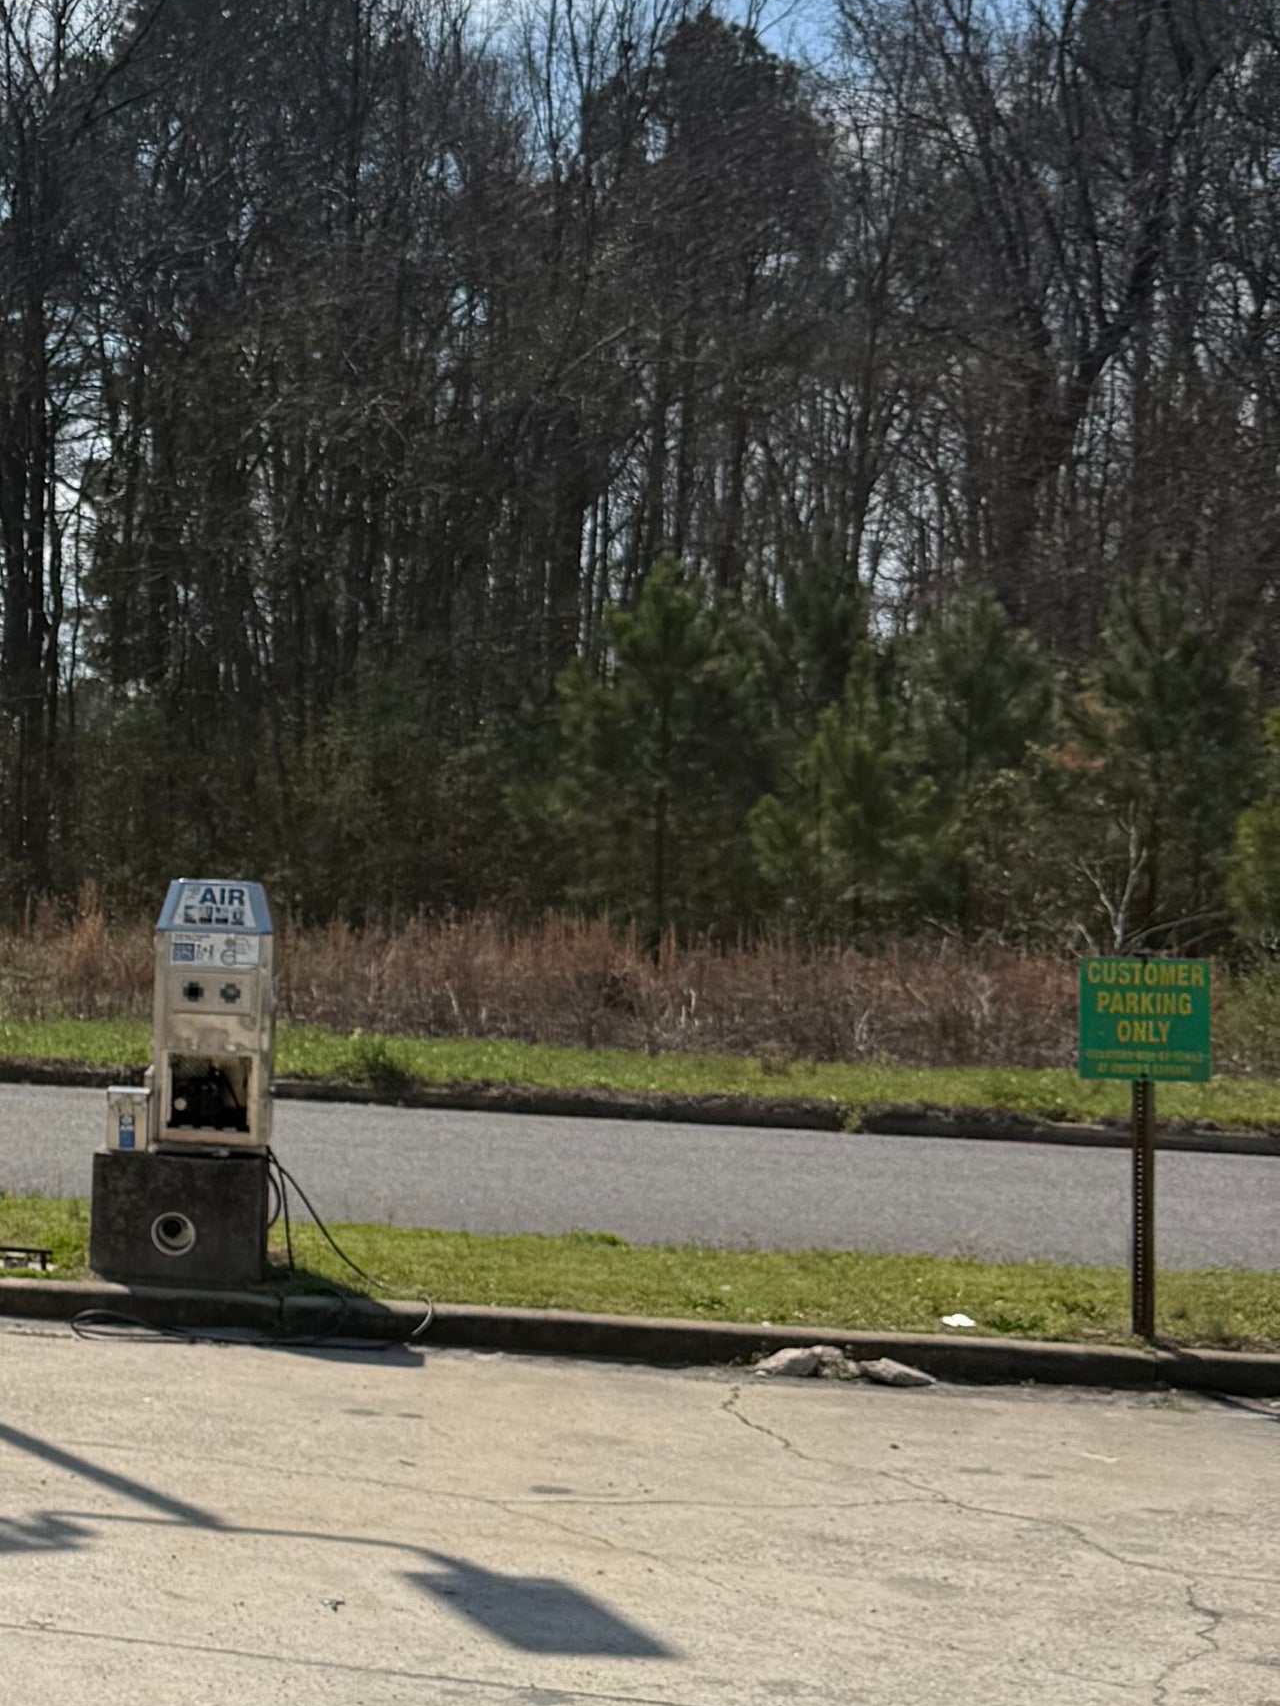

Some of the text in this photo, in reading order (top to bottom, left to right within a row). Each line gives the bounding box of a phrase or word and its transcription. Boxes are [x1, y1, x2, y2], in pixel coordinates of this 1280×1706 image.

[199, 887, 245, 906] AIR
[1087, 961, 1205, 987] CUSTOMER
[1096, 990, 1193, 1016] PARKING
[1116, 1019, 1171, 1044] ONLY
